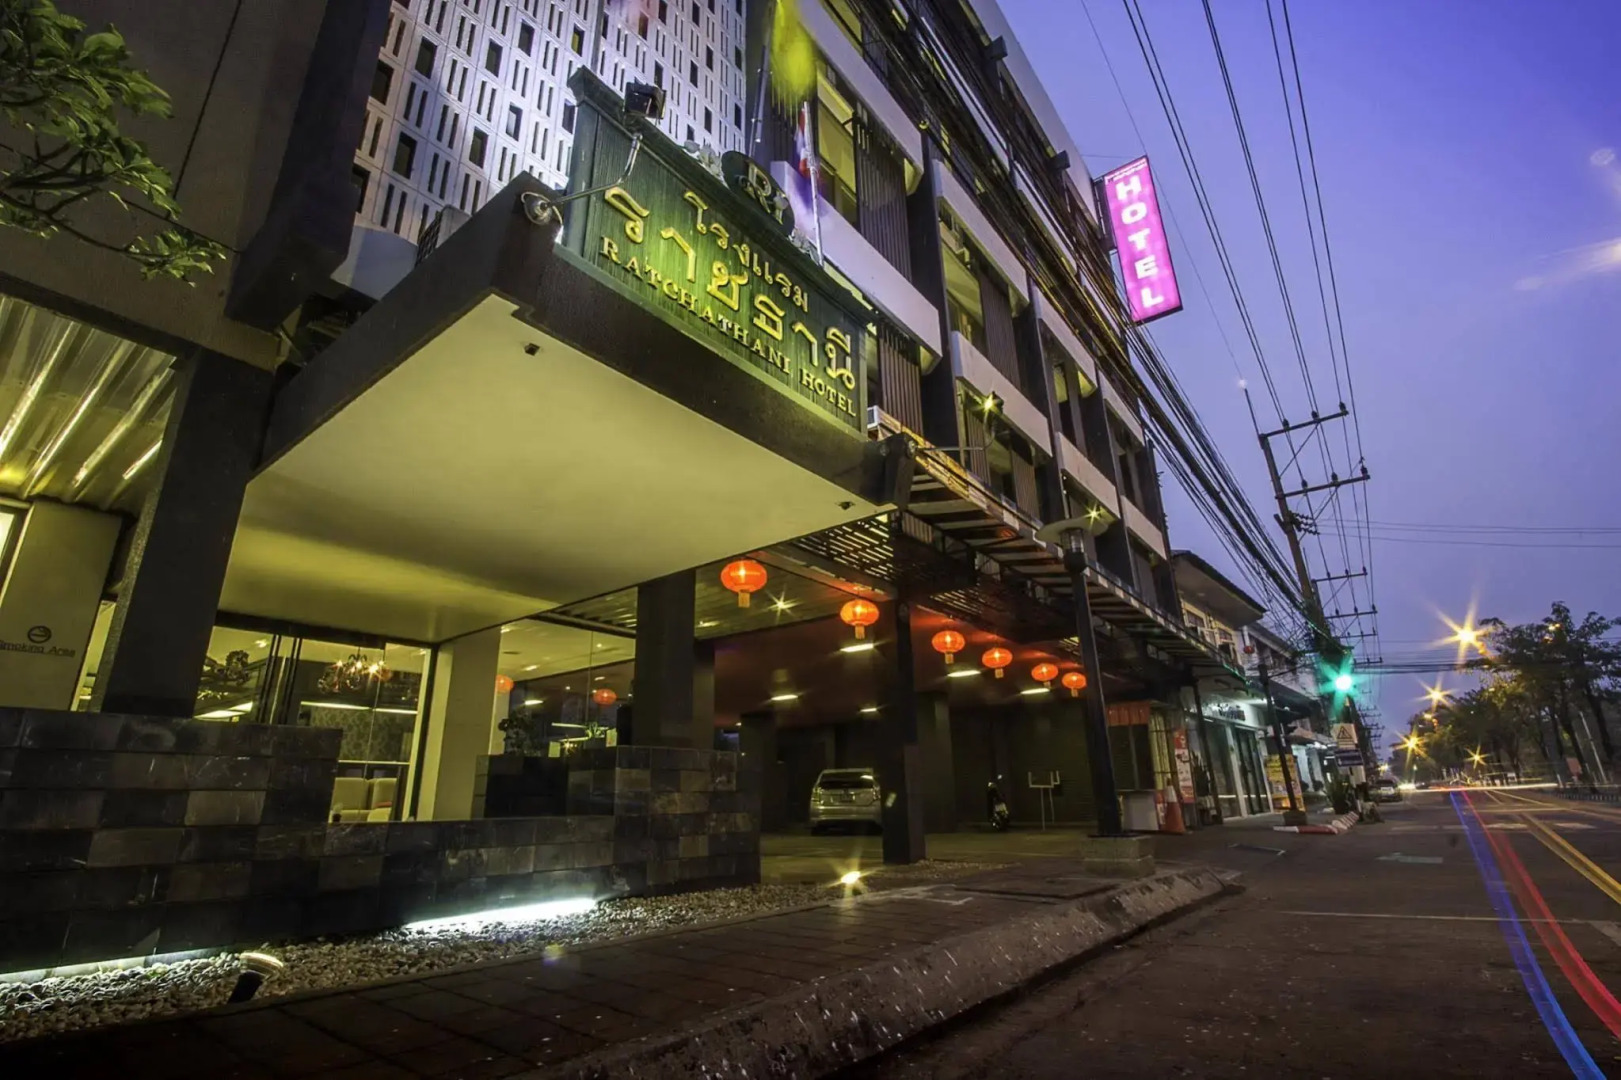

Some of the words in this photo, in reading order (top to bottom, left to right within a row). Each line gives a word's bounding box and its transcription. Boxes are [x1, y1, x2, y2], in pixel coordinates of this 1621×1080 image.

[605, 186, 856, 390] ราชธานี
[684, 191, 809, 313] โรงแรม
[1115, 174, 1164, 308] HOTEL
[600, 236, 791, 375] RATCHATHANI
[801, 367, 857, 417] HOTEL
